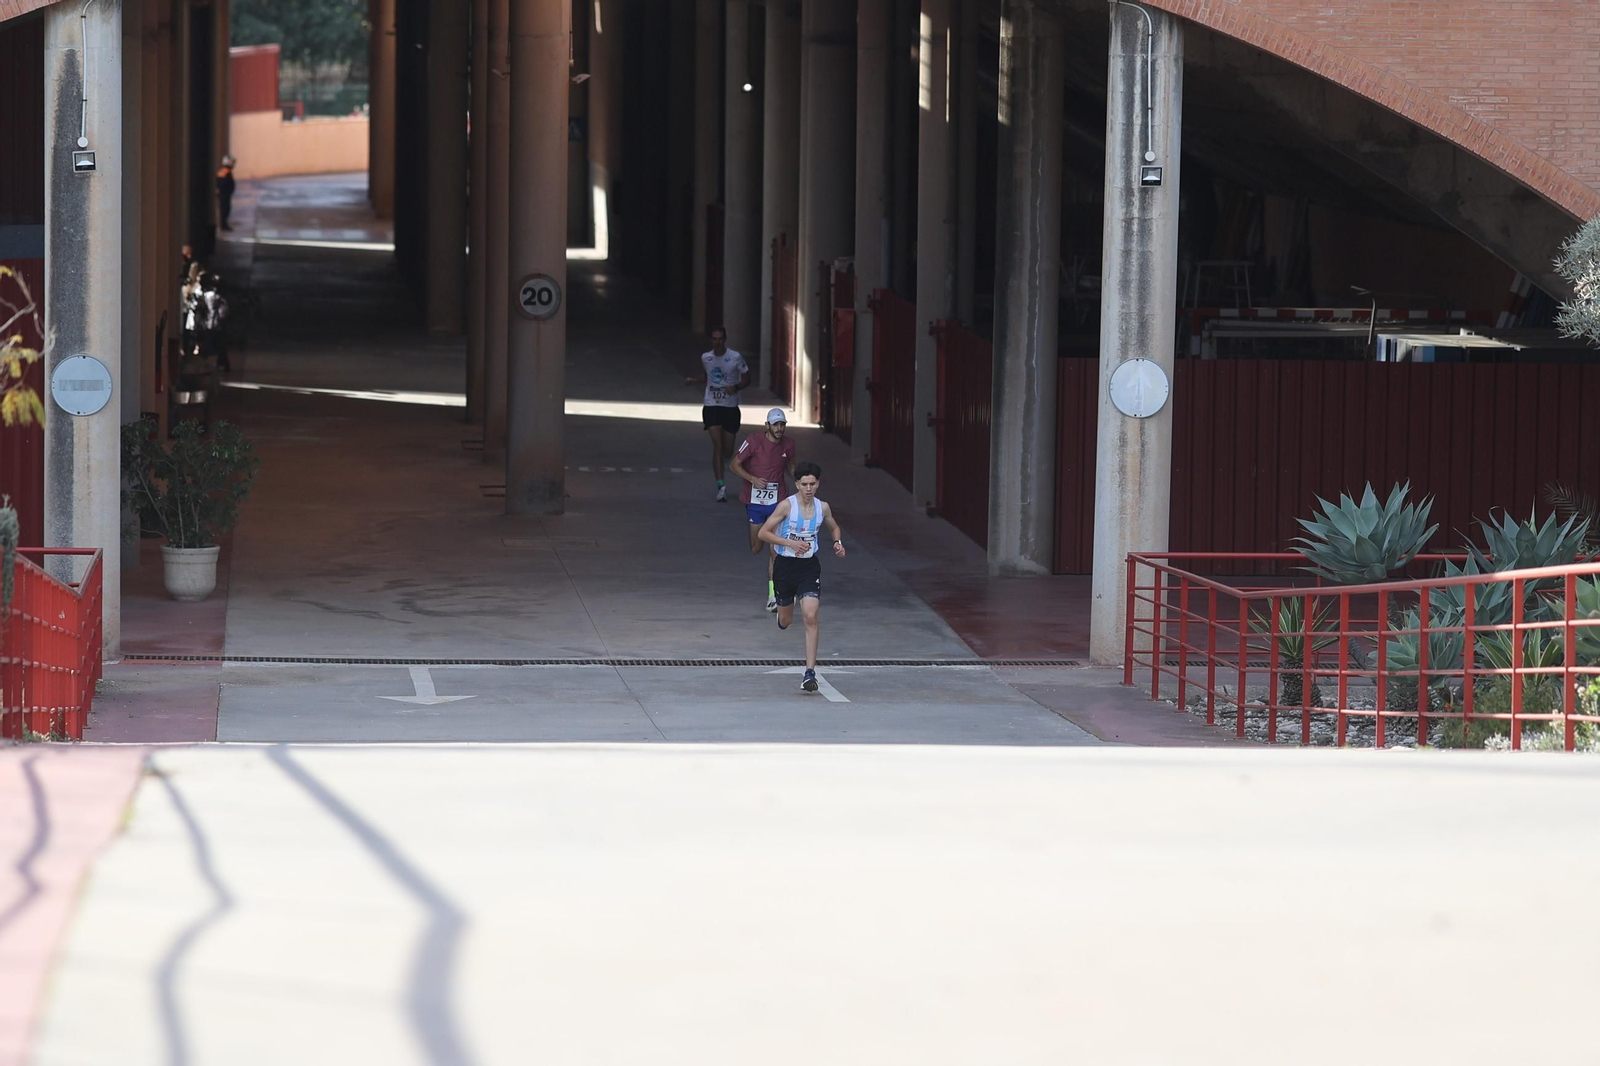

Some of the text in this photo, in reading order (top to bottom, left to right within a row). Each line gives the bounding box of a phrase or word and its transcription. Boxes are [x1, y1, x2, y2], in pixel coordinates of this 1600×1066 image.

[522, 287, 552, 306] 20
[712, 391, 727, 399] 102
[756, 490, 774, 500] 276
